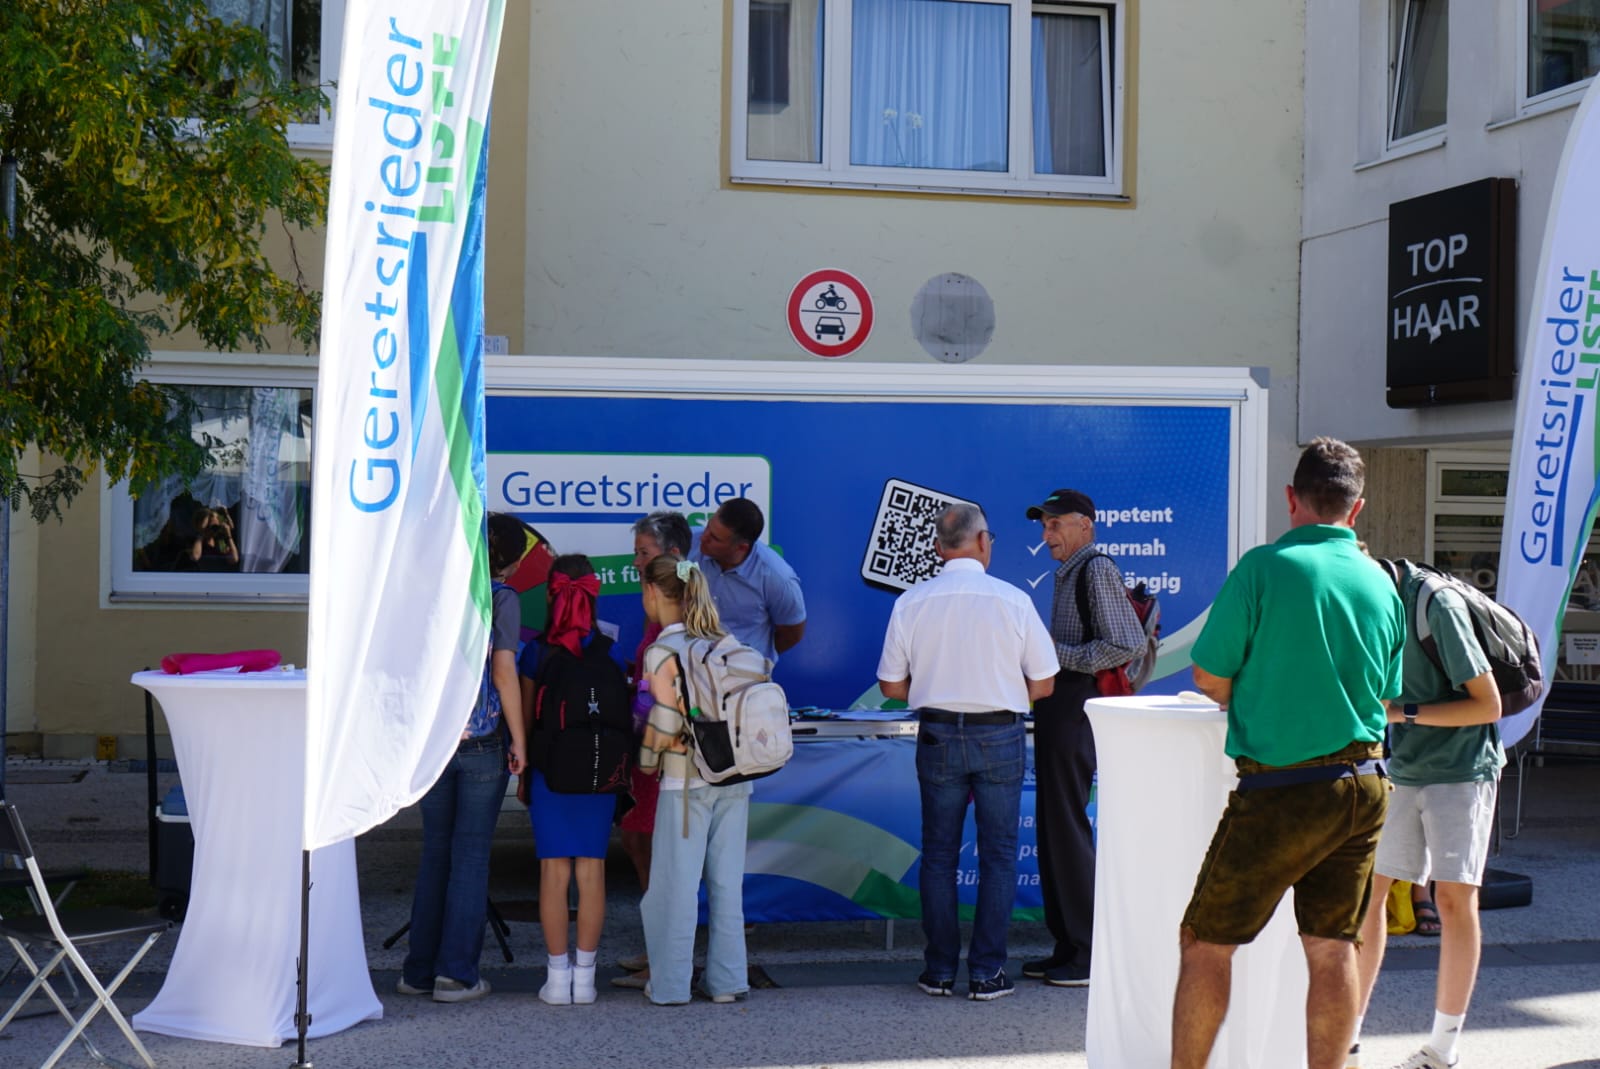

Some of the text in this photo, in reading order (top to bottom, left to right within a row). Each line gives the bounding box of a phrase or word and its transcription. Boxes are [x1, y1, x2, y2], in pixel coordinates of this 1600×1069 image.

[349, 17, 424, 513] Geretsrieder
[1407, 234, 1468, 276] TOP
[1393, 295, 1480, 340] HAAR
[1521, 266, 1585, 564] Geretsrieder
[502, 471, 752, 507] Geretsrieder
[1095, 507, 1173, 527] mpetent
